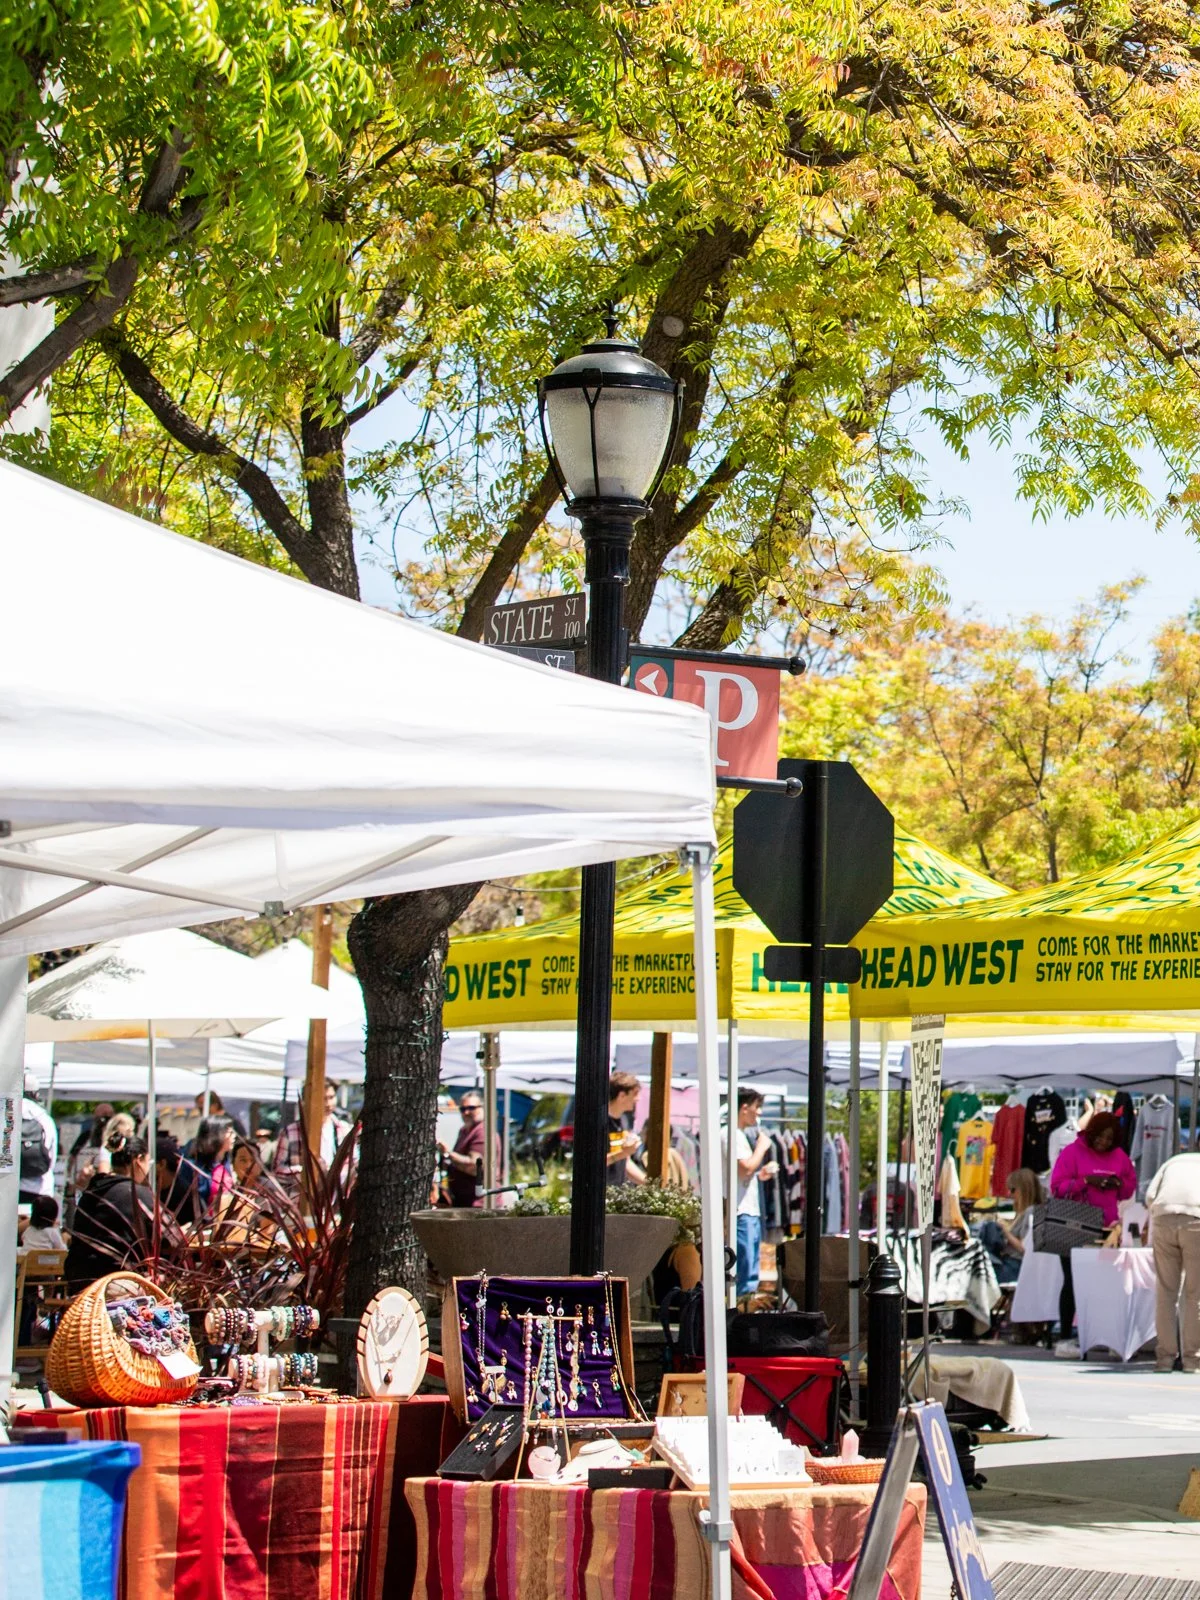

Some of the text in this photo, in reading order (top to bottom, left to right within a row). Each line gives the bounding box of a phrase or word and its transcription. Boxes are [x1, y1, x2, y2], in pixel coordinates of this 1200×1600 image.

[488, 597, 580, 646] STATE ST
[563, 620, 581, 640] 100
[544, 654, 566, 669] ST
[695, 669, 759, 767] P
[1037, 936, 1078, 957] COME
[1083, 935, 1111, 956] FOR
[1116, 934, 1143, 955] THE
[542, 952, 720, 974] COME HE MARKETPLE
[861, 944, 937, 990] HEAD
[942, 939, 1024, 986] WEST
[1036, 961, 1072, 983] STAY
[1077, 961, 1104, 982] FOR
[1110, 960, 1138, 981] THE
[464, 958, 532, 1001] WEST
[541, 977, 571, 996] STAY
[612, 977, 625, 995] HE
[629, 975, 695, 994] EXPERIENC
